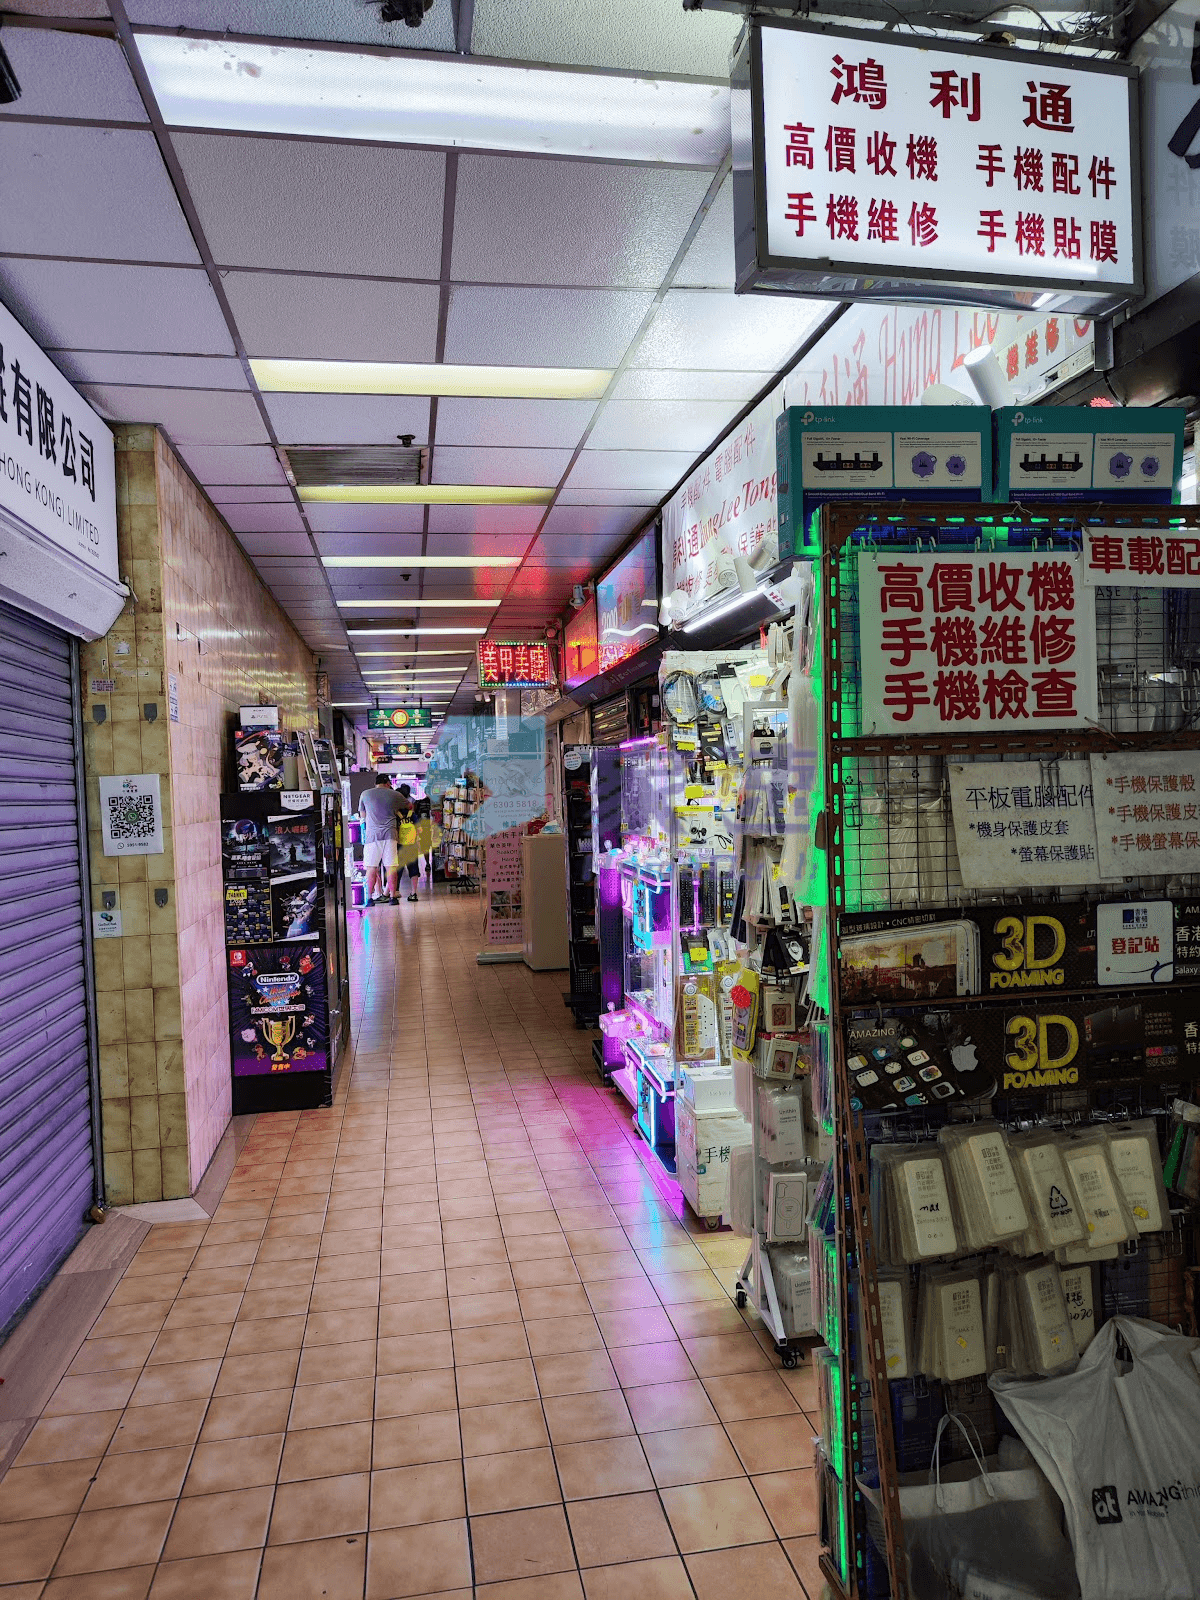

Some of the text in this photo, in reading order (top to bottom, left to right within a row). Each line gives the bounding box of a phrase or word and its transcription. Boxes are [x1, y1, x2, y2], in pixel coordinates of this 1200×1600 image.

[830, 54, 1075, 133] 鴻利通
[784, 122, 1117, 200] 高價收機 手機配件
[784, 192, 939, 248] 手機維修
[977, 209, 1118, 265] 手機貼膜
[67, 508, 100, 546] LIMITED
[1088, 534, 1200, 576] 車載配
[877, 561, 1075, 613] 高價收機
[880, 614, 1076, 667] 手機維修
[882, 668, 1077, 721] 手機檢查
[493, 799, 537, 809] 6303 5818
[965, 784, 1093, 810] 平板電腦配件
[992, 915, 1066, 971] 3D
[1111, 936, 1160, 954] 登記站
[260, 975, 296, 983] Nintendo
[989, 968, 1065, 988] FOAMING
[850, 1027, 895, 1039] AMAZING
[1004, 1014, 1079, 1071] 3D
[1003, 1067, 1079, 1091] FOAMING
